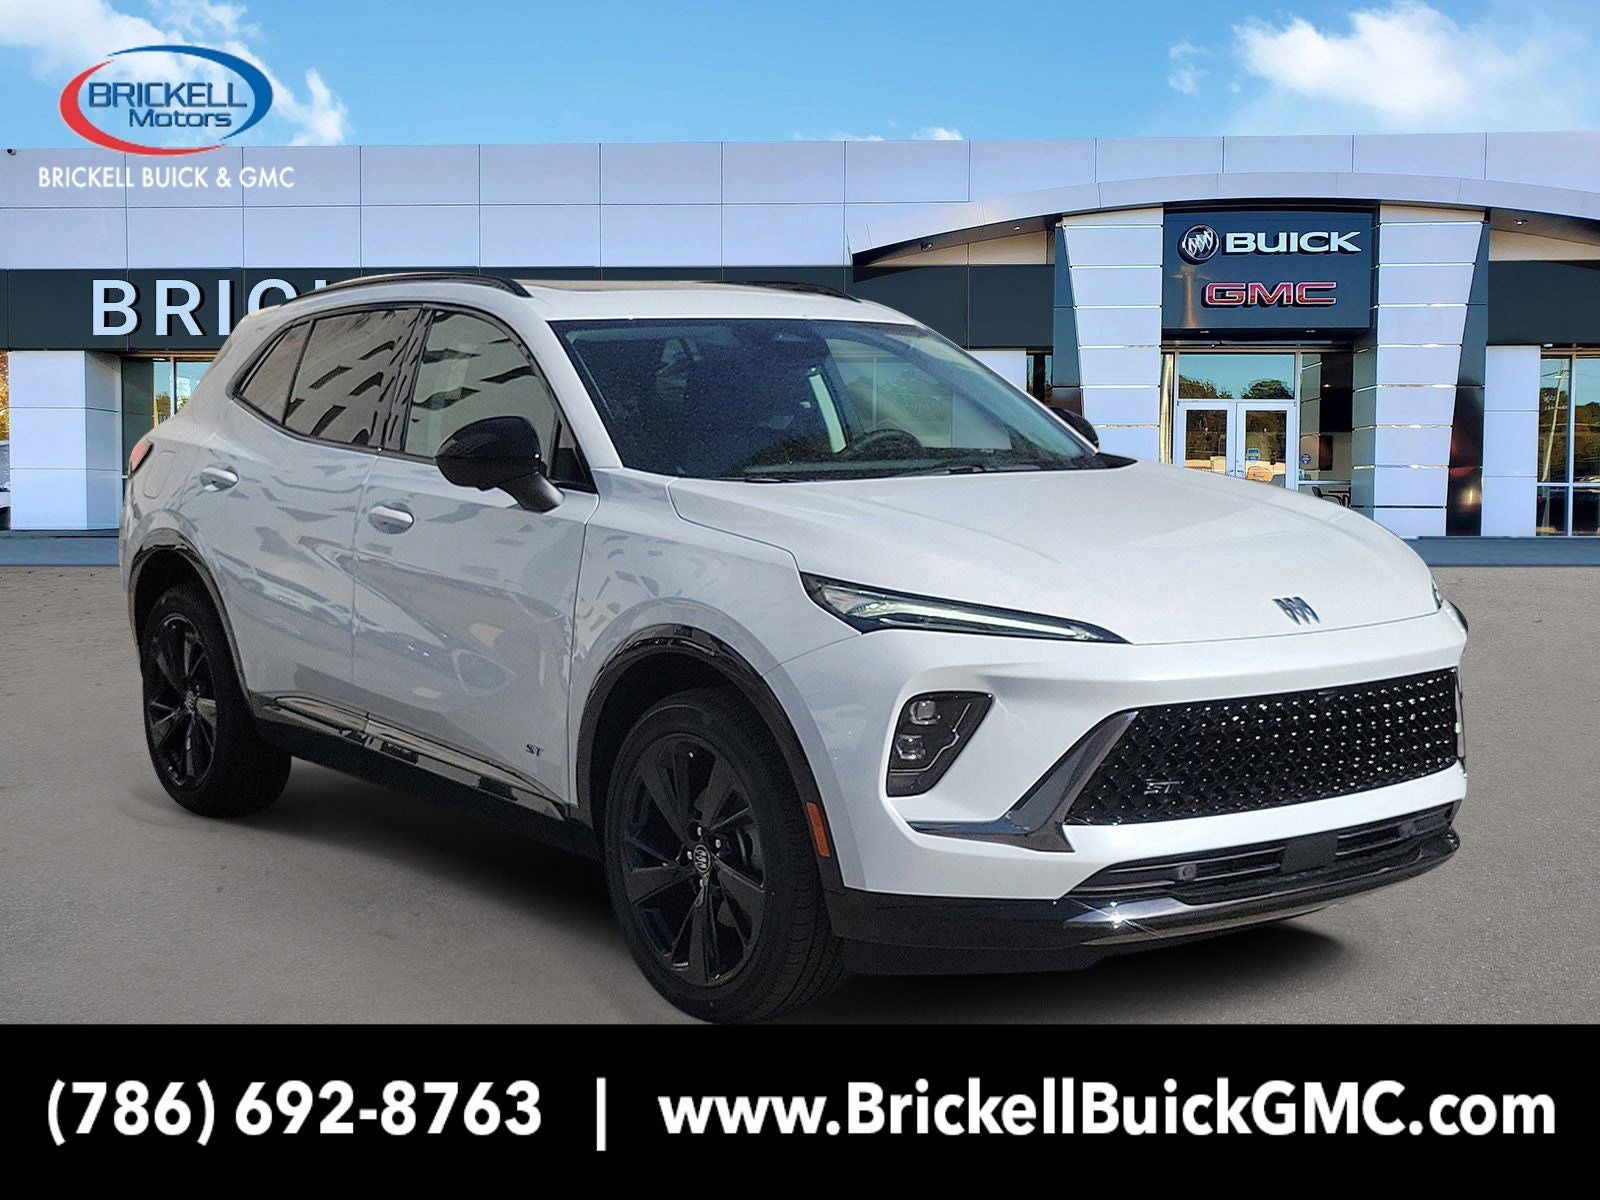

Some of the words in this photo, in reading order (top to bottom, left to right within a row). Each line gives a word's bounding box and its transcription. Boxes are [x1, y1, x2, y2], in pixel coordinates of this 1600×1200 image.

[1225, 231, 1361, 253] BUICK
[1205, 282, 1337, 305] GMC
[92, 278, 327, 336] BRIC
[526, 744, 545, 757] ST
